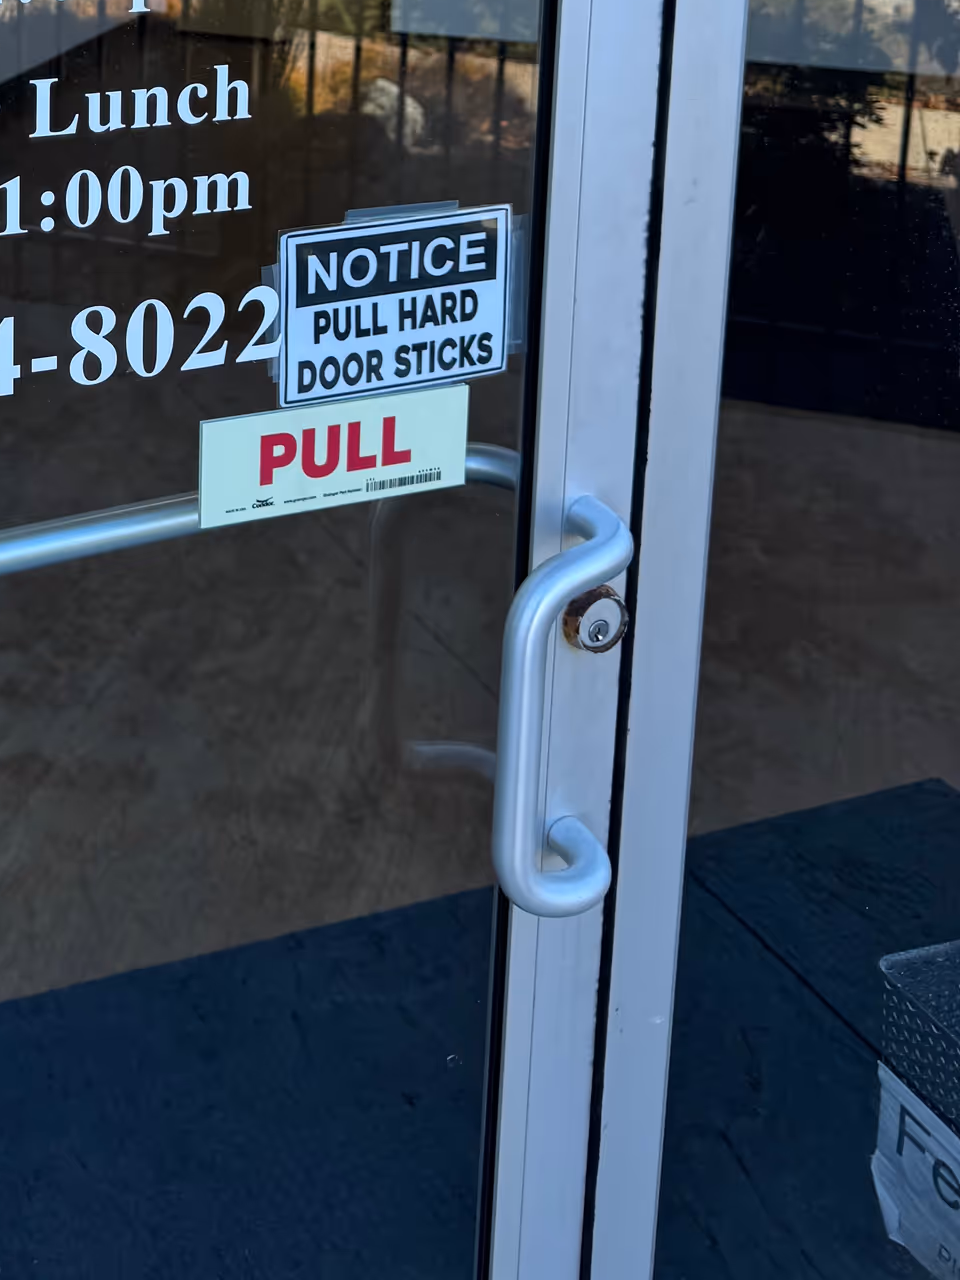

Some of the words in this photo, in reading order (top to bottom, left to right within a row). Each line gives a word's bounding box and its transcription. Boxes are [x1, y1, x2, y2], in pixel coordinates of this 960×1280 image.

[28, 64, 252, 139] Lunch
[306, 231, 488, 295] NOTICE
[313, 302, 388, 344] PULL
[398, 288, 479, 332] HARD
[297, 349, 384, 394] DOOR
[394, 332, 494, 379] STICKS
[259, 415, 412, 486] PULL
